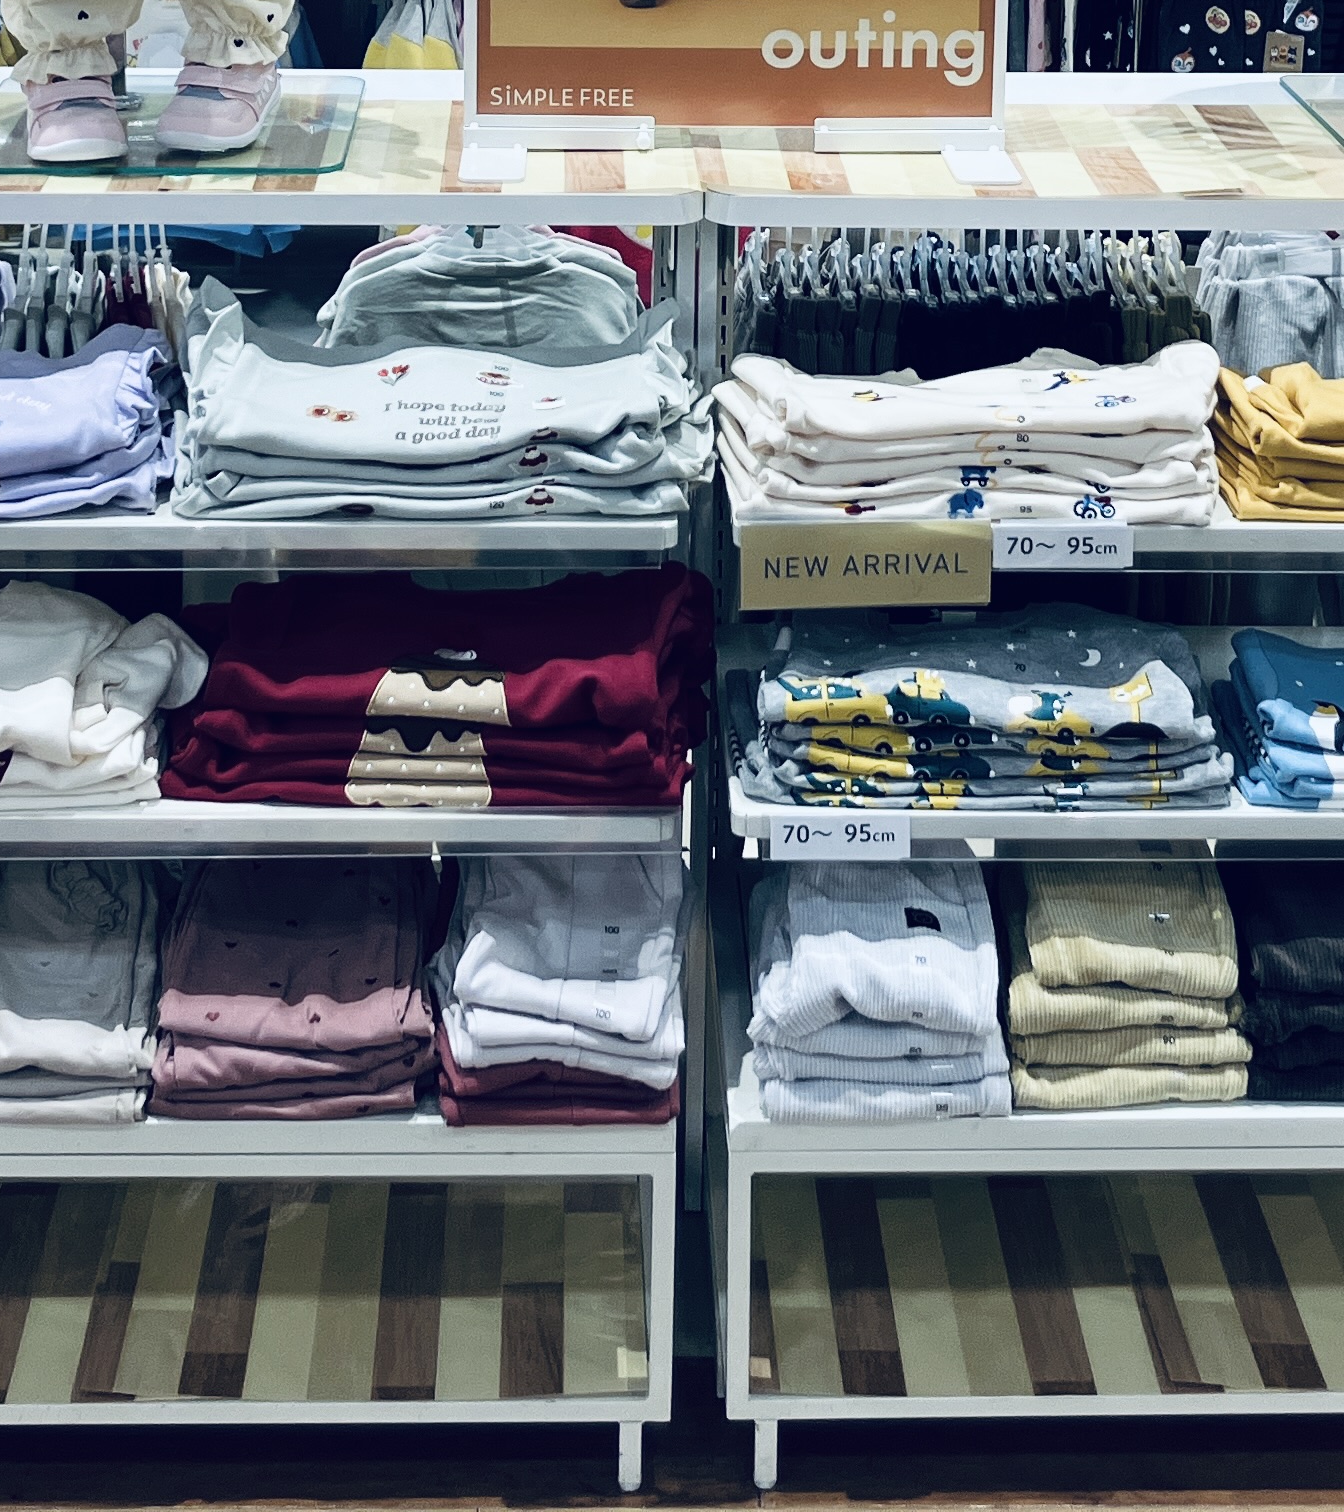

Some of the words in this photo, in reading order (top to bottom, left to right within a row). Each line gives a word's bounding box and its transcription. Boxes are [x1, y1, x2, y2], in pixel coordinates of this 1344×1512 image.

[760, 10, 985, 87] outing
[579, 87, 635, 108] FREE
[397, 400, 445, 412] hope
[449, 402, 506, 413] today
[418, 416, 457, 426] will
[461, 416, 483, 425] be
[395, 431, 407, 440] a
[412, 428, 462, 444] good
[465, 425, 502, 439] day
[1016, 433, 1030, 443] 80
[1067, 536, 1118, 556] 95cm
[763, 555, 829, 580] NEW
[842, 552, 969, 577] ARRIVAL
[1014, 662, 1027, 672] 70
[844, 823, 896, 844] 95cm
[604, 925, 620, 934] 100
